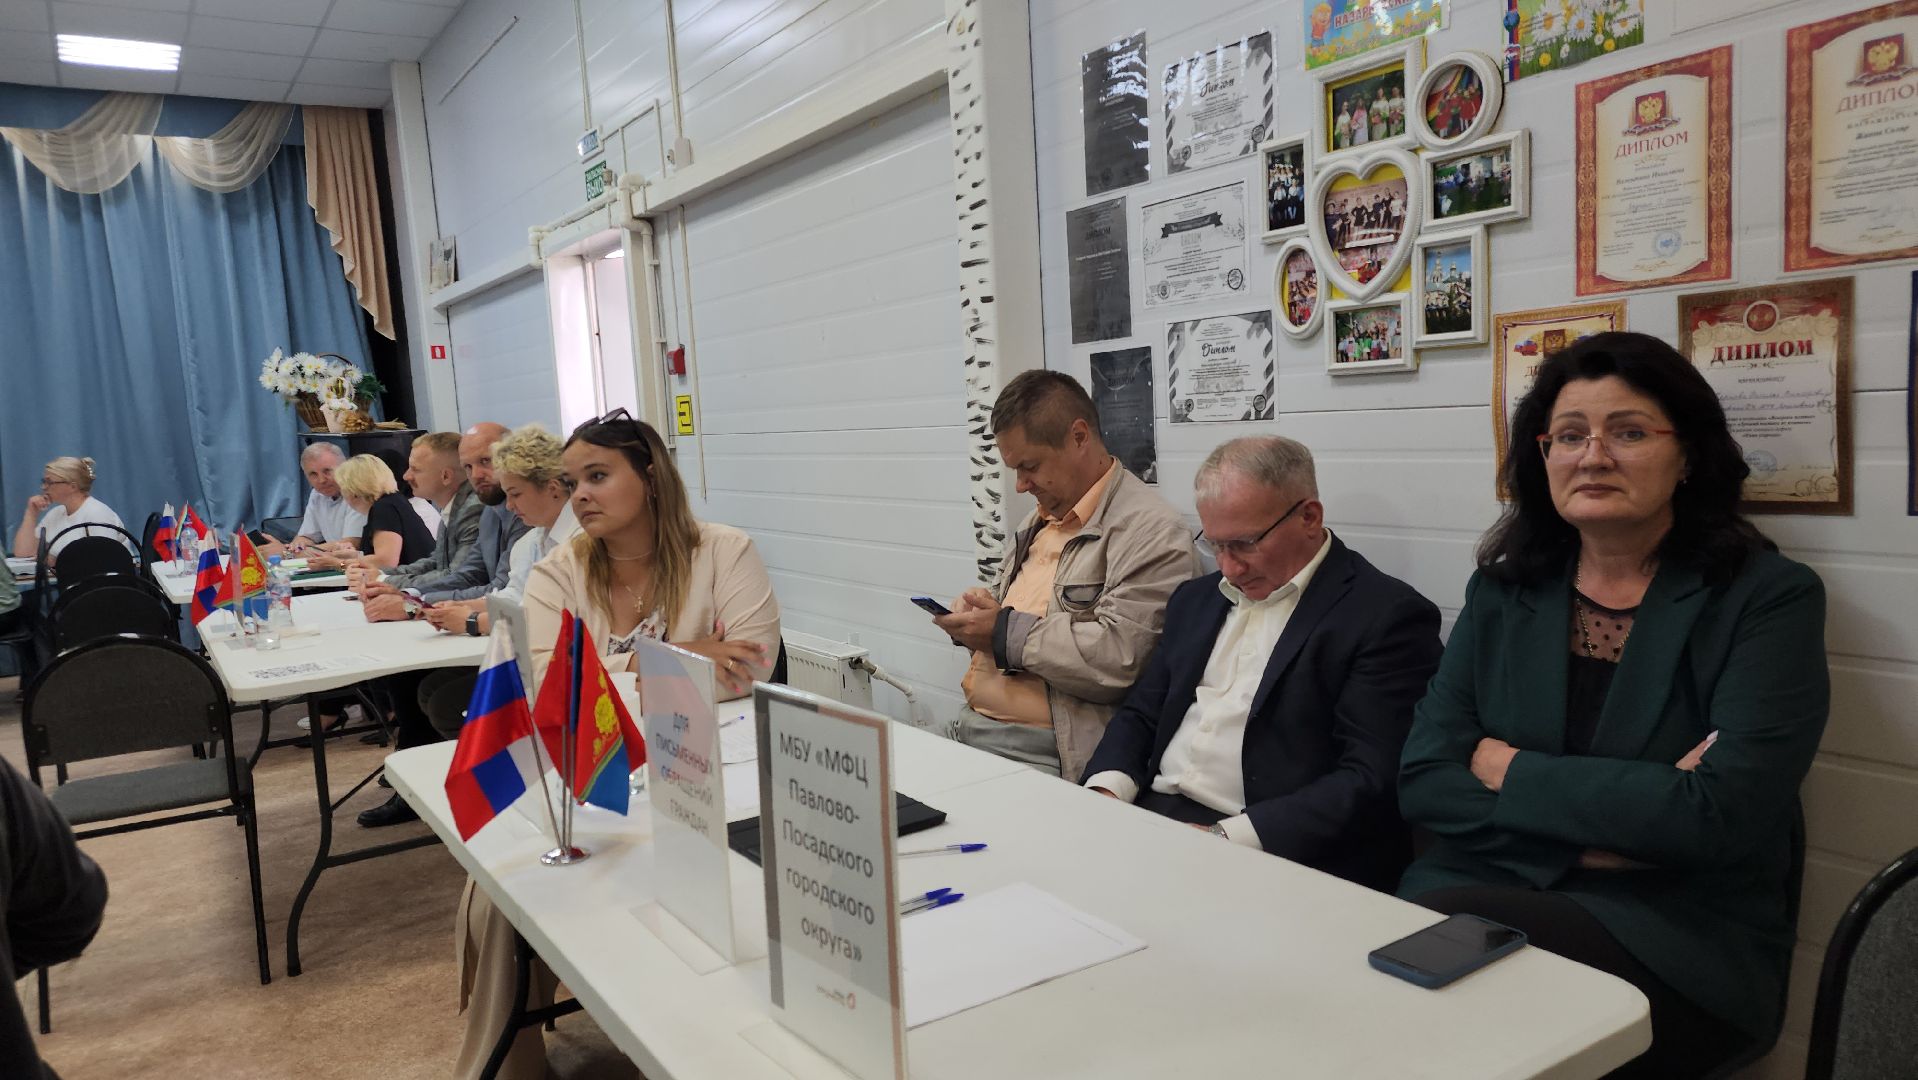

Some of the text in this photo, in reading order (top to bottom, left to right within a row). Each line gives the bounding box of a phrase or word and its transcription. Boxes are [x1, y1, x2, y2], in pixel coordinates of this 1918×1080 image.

[1835, 82, 1918, 115] ДИПЛО
[1614, 131, 1689, 160] ДИПЛОМ
[1710, 339, 1815, 365] ДИПЛОМ
[673, 711, 689, 735] ДЛЯ
[780, 732, 869, 789] МБУ «МФЦ
[788, 778, 860, 824] Павлово-
[783, 819, 874, 879] Посадского
[786, 867, 875, 925] городского
[801, 917, 863, 962] округа»
